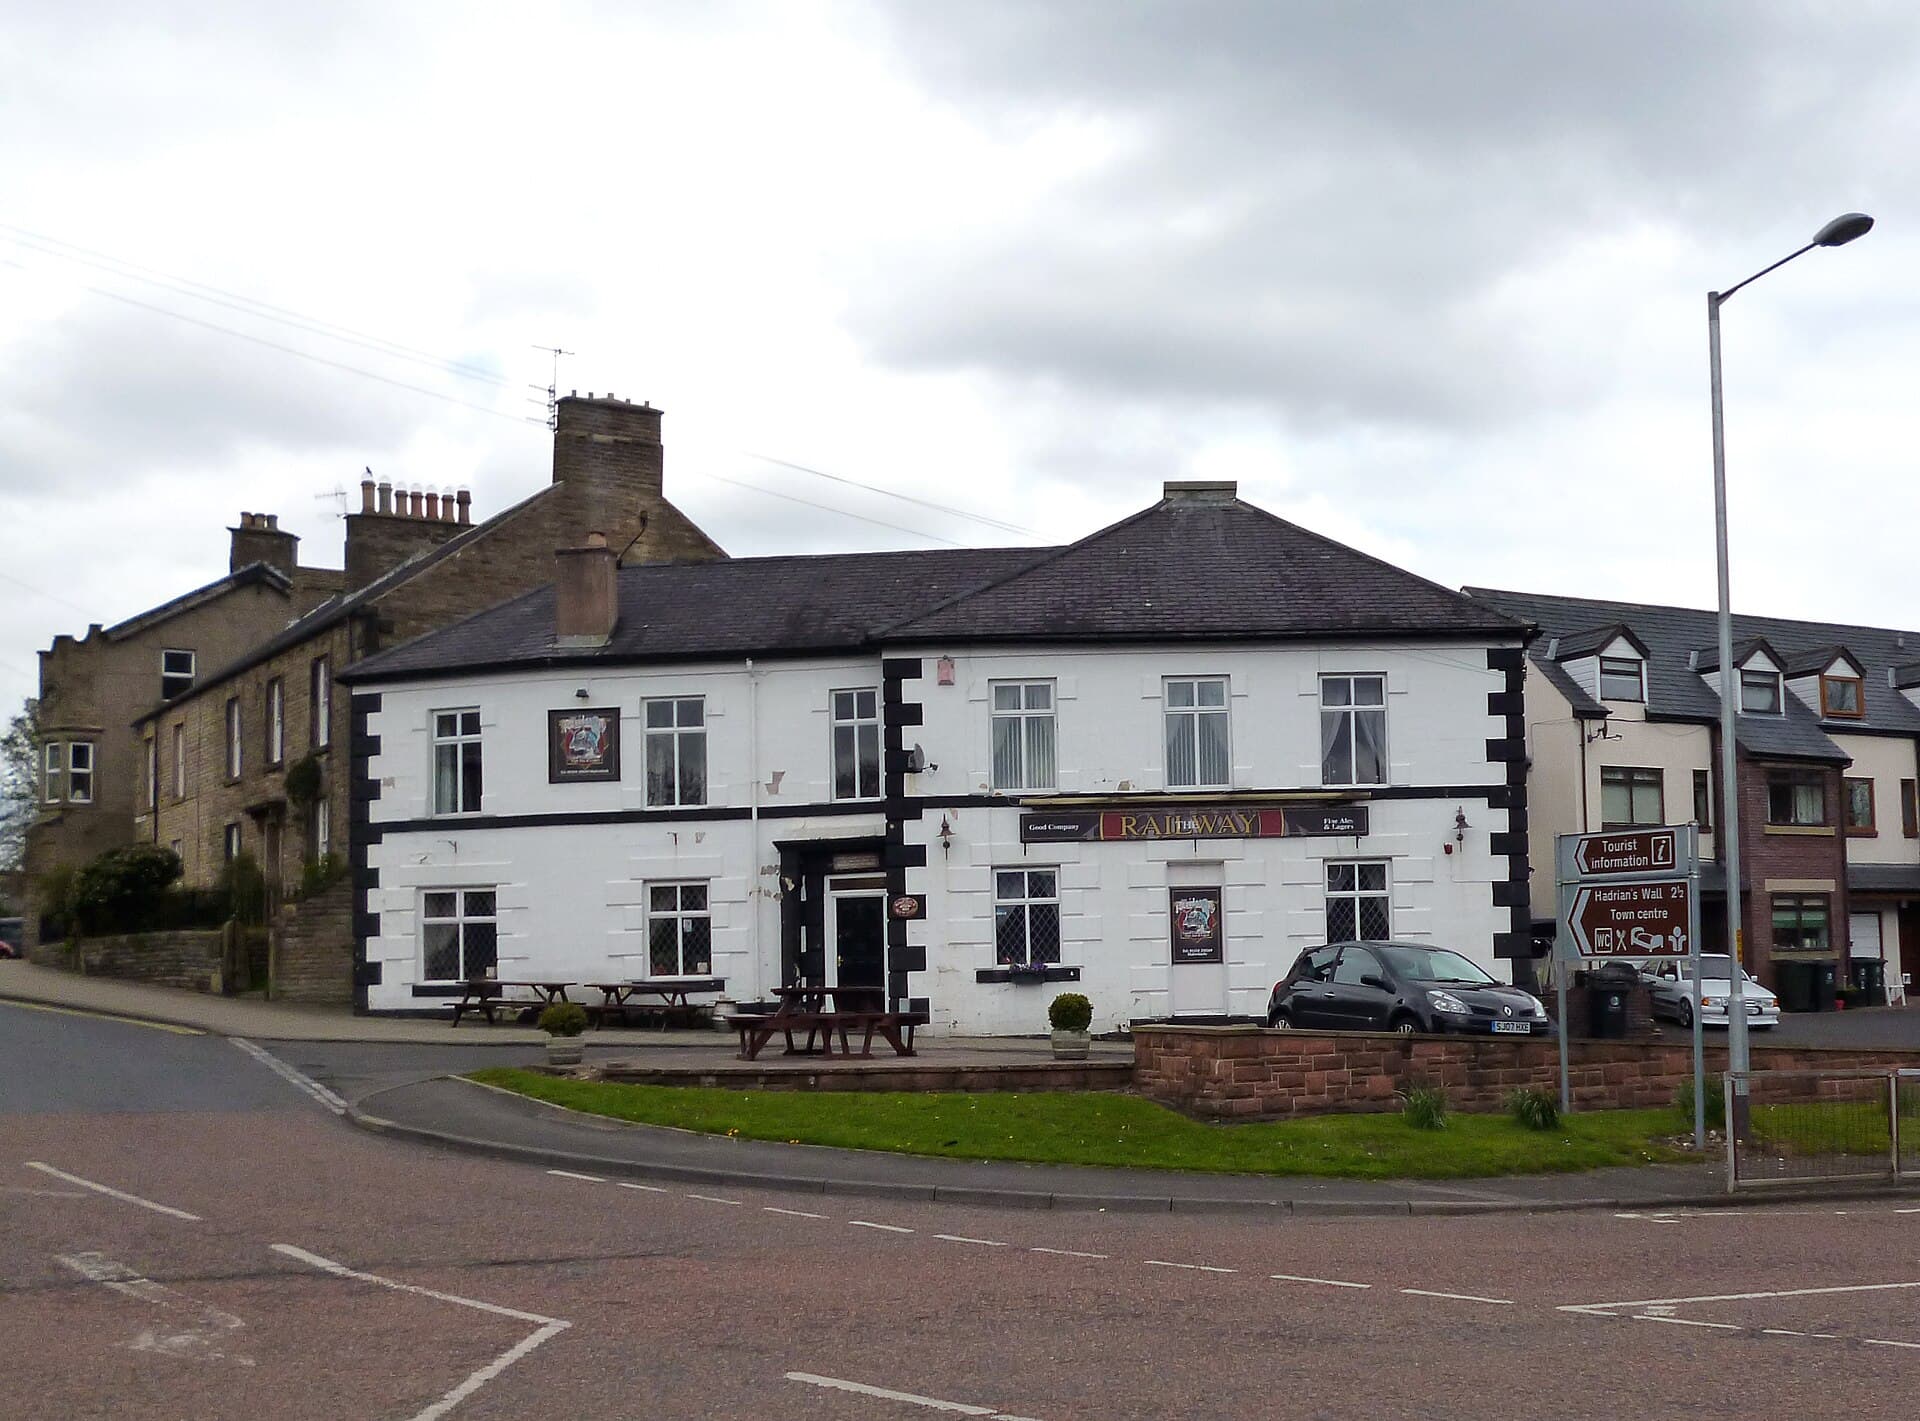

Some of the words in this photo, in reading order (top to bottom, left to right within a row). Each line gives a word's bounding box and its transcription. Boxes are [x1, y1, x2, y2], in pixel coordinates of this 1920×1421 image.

[1029, 823, 1047, 831] Good
[1048, 823, 1079, 832] Company
[1121, 815, 1256, 836] RAILWAY
[1602, 839, 1638, 853] Tourist
[1591, 855, 1648, 869] information
[1594, 888, 1638, 902] Hadrian's
[1641, 888, 1663, 899] Wall
[1610, 908, 1635, 921] Town
[1637, 908, 1668, 919] centre
[1596, 932, 1611, 948] WC
[1497, 1023, 1515, 1031] SJ07
